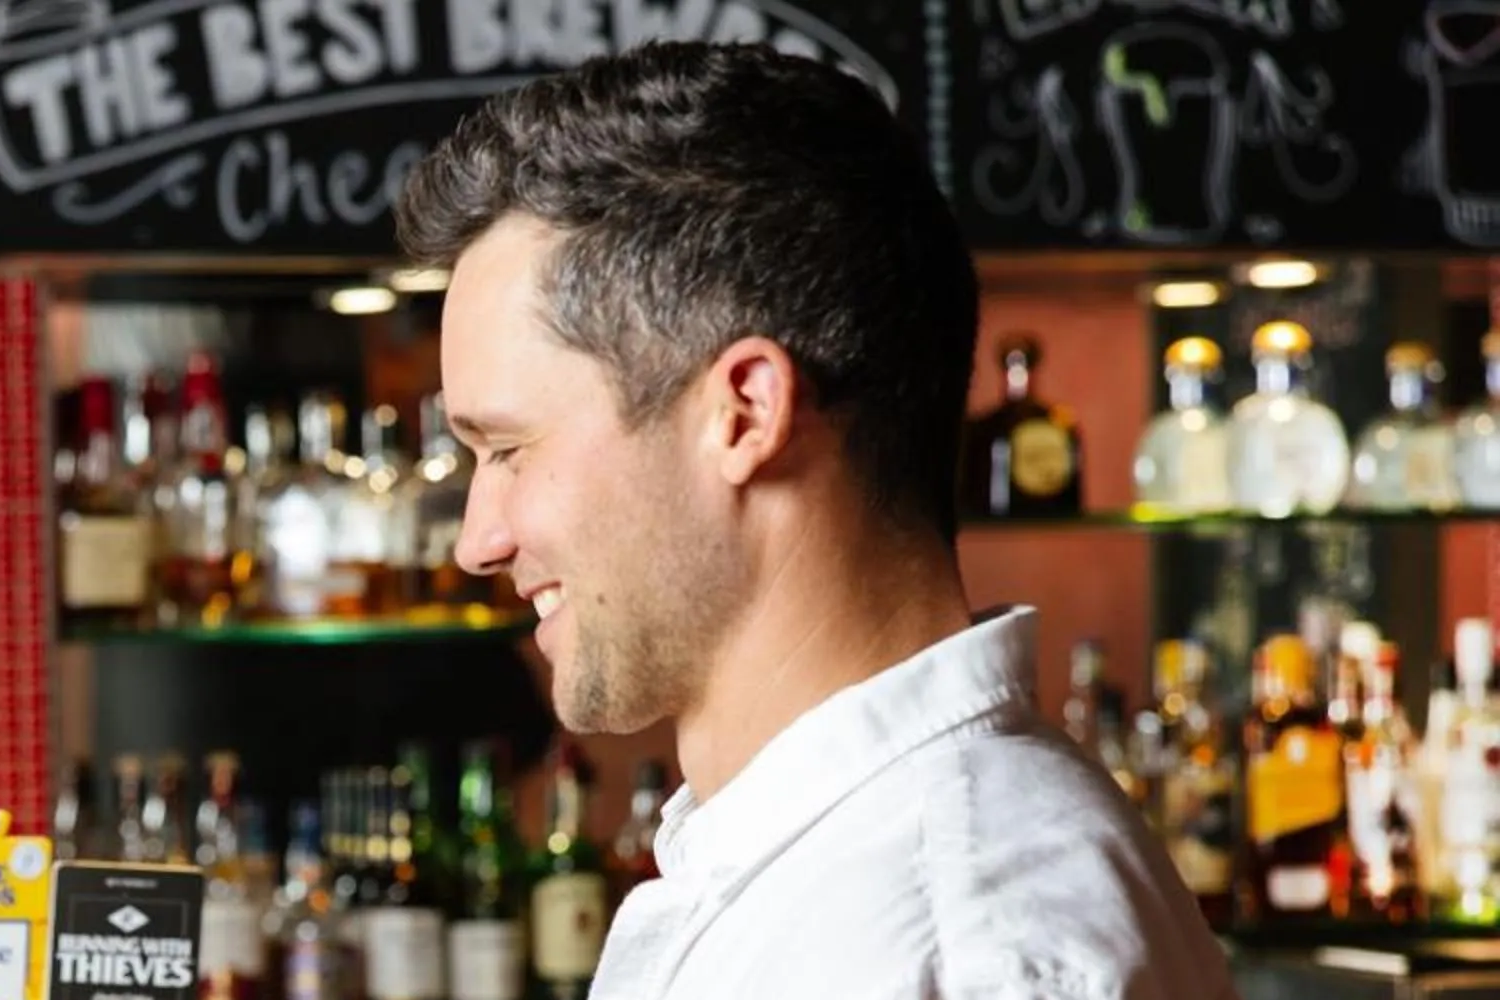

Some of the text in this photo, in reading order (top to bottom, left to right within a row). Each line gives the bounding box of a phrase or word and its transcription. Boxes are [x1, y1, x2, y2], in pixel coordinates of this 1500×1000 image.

[3, 22, 190, 165] THE
[203, 0, 418, 102] BEST
[55, 950, 195, 989] THIEVES
